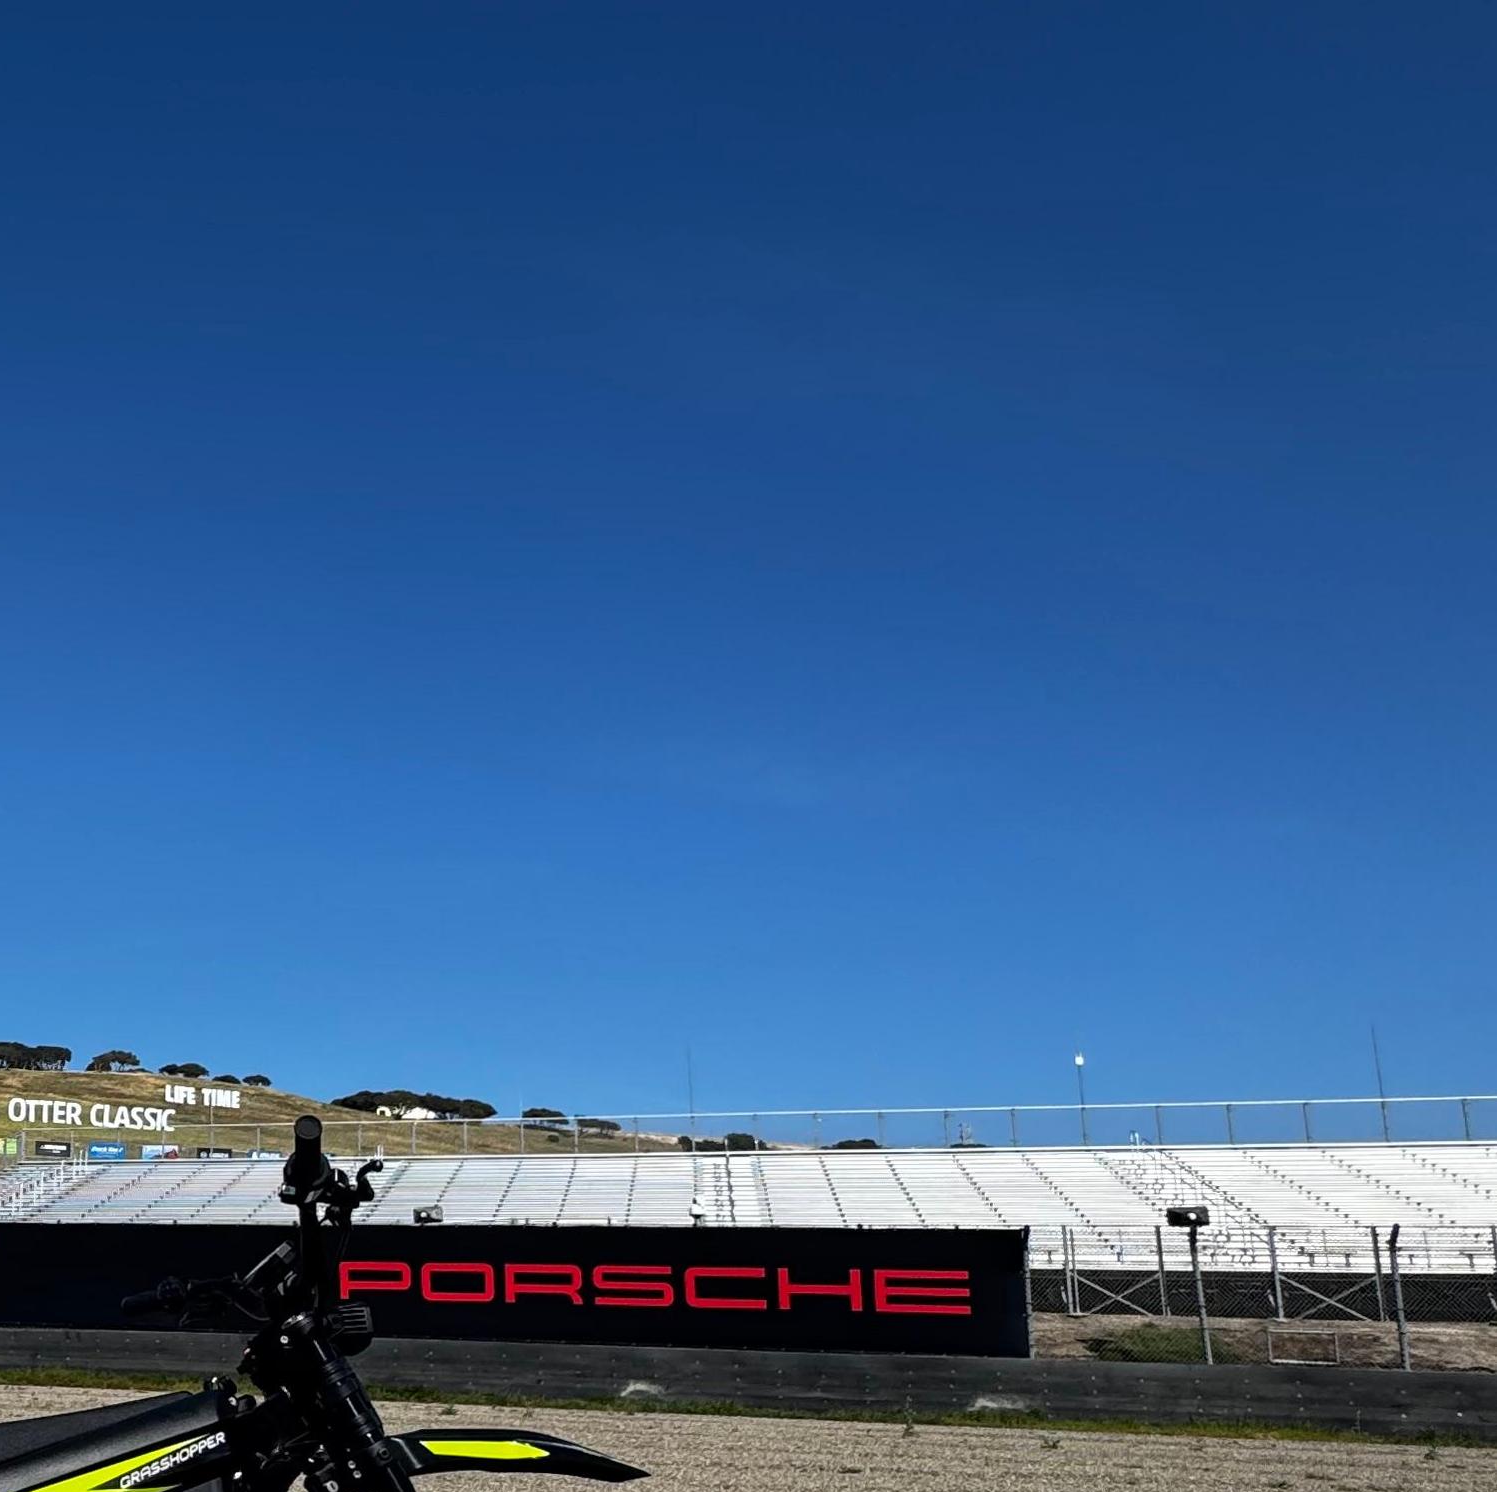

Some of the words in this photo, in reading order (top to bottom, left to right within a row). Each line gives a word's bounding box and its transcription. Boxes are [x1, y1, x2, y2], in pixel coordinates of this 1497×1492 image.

[8, 1097, 82, 1126] OTTER
[90, 1103, 176, 1132] CLASSIC
[165, 1084, 196, 1105] LIFE
[201, 1088, 241, 1109] TIME
[339, 1261, 971, 1315] PORSCHE
[120, 1431, 226, 1489] GRASSHOPPER
